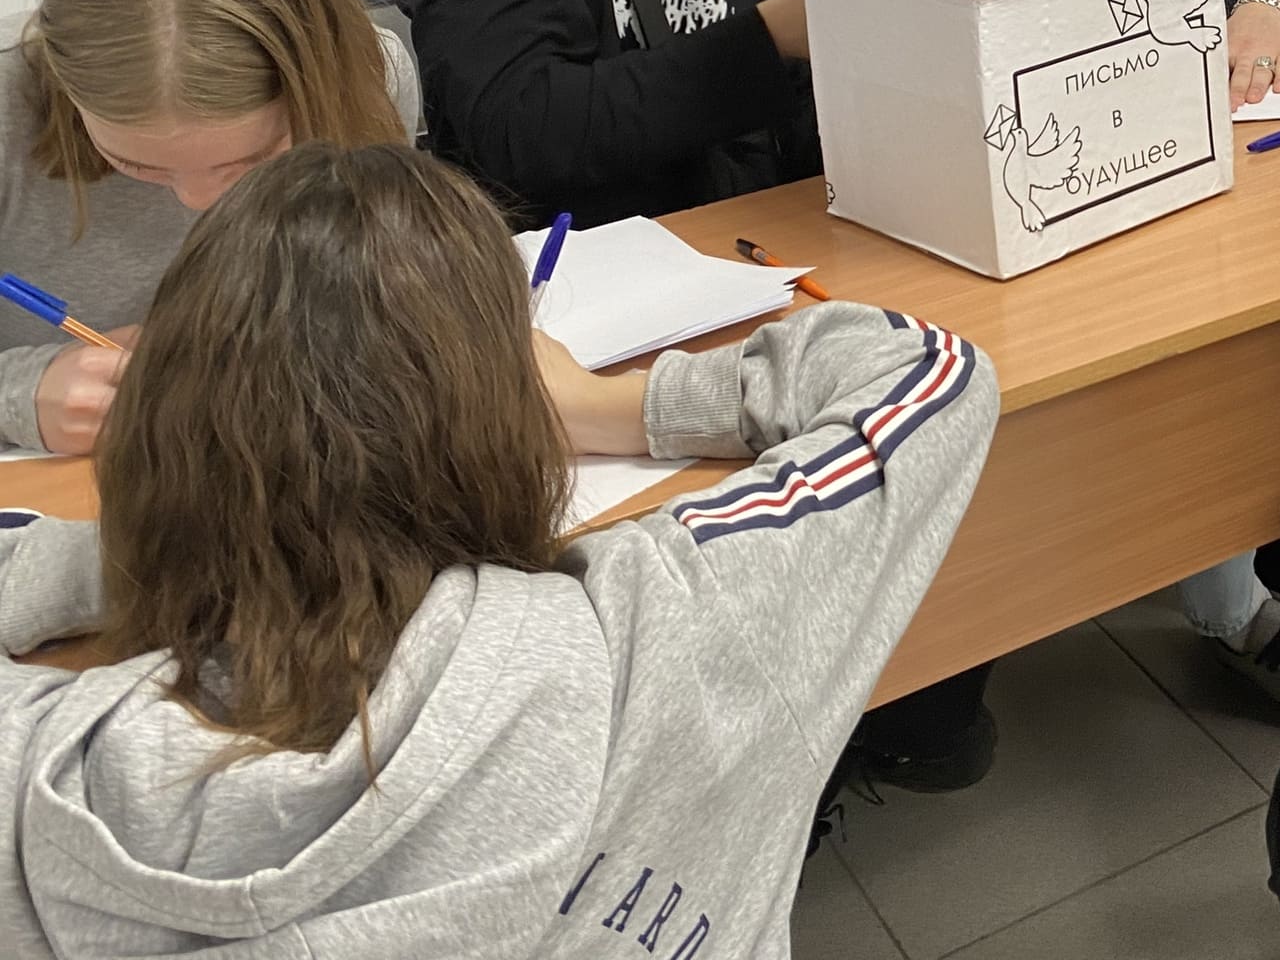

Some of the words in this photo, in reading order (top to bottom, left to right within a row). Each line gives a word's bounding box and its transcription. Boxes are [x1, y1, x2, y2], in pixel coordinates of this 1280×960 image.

[1065, 48, 1160, 96] письмо
[1112, 109, 1123, 128] в
[1064, 139, 1178, 195] будущее
